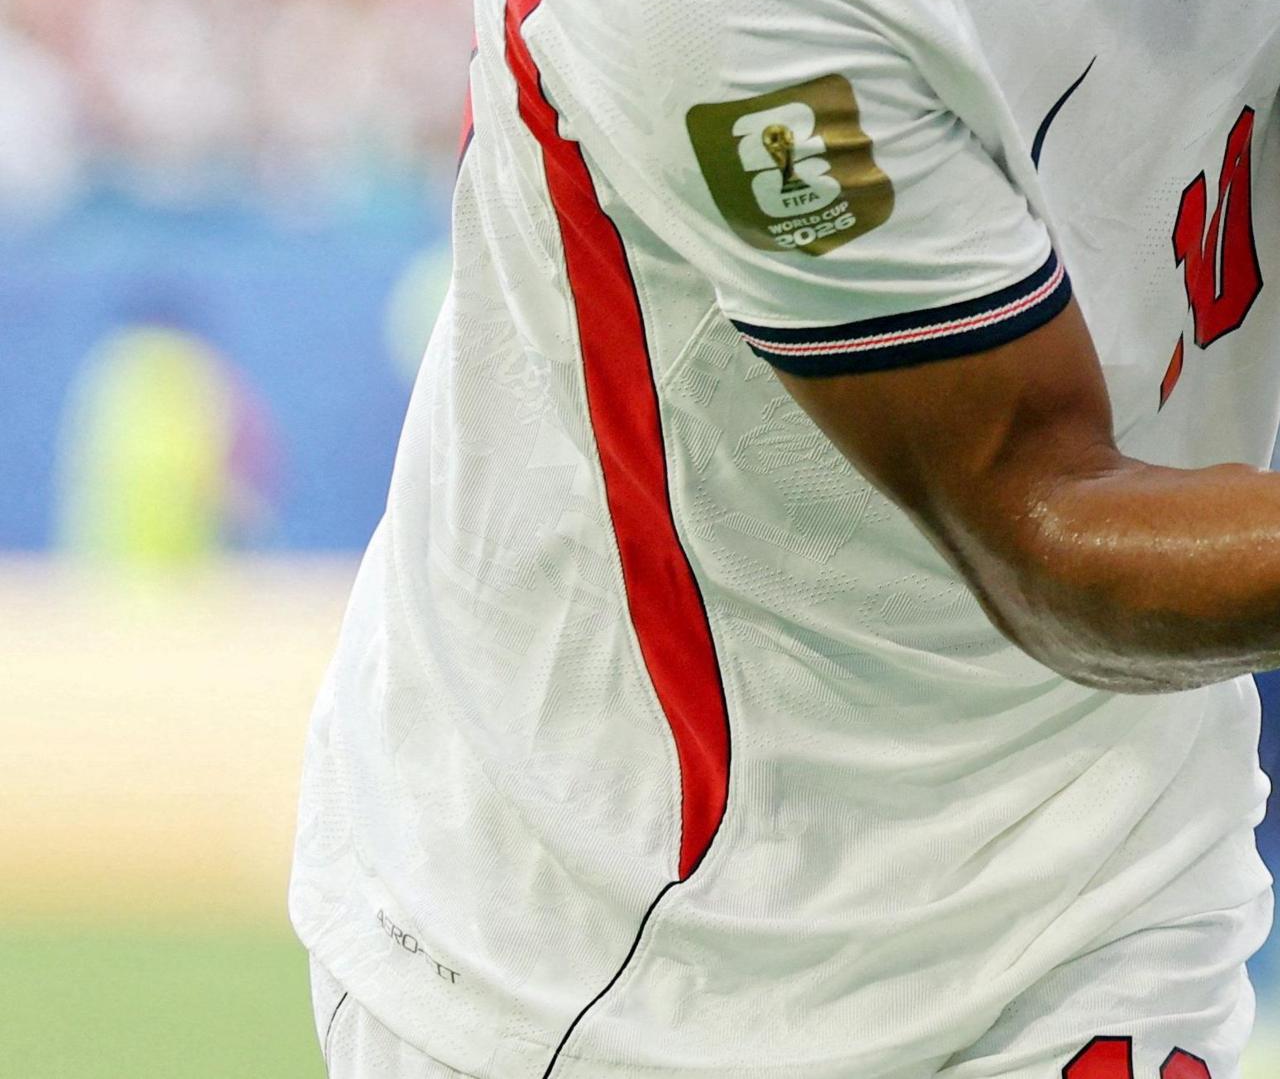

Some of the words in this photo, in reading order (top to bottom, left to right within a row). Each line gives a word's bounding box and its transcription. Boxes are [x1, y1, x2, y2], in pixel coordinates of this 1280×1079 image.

[782, 192, 820, 208] FIFA
[768, 215, 821, 235] WORLD
[822, 201, 849, 220] CUP
[775, 212, 857, 248] 2026
